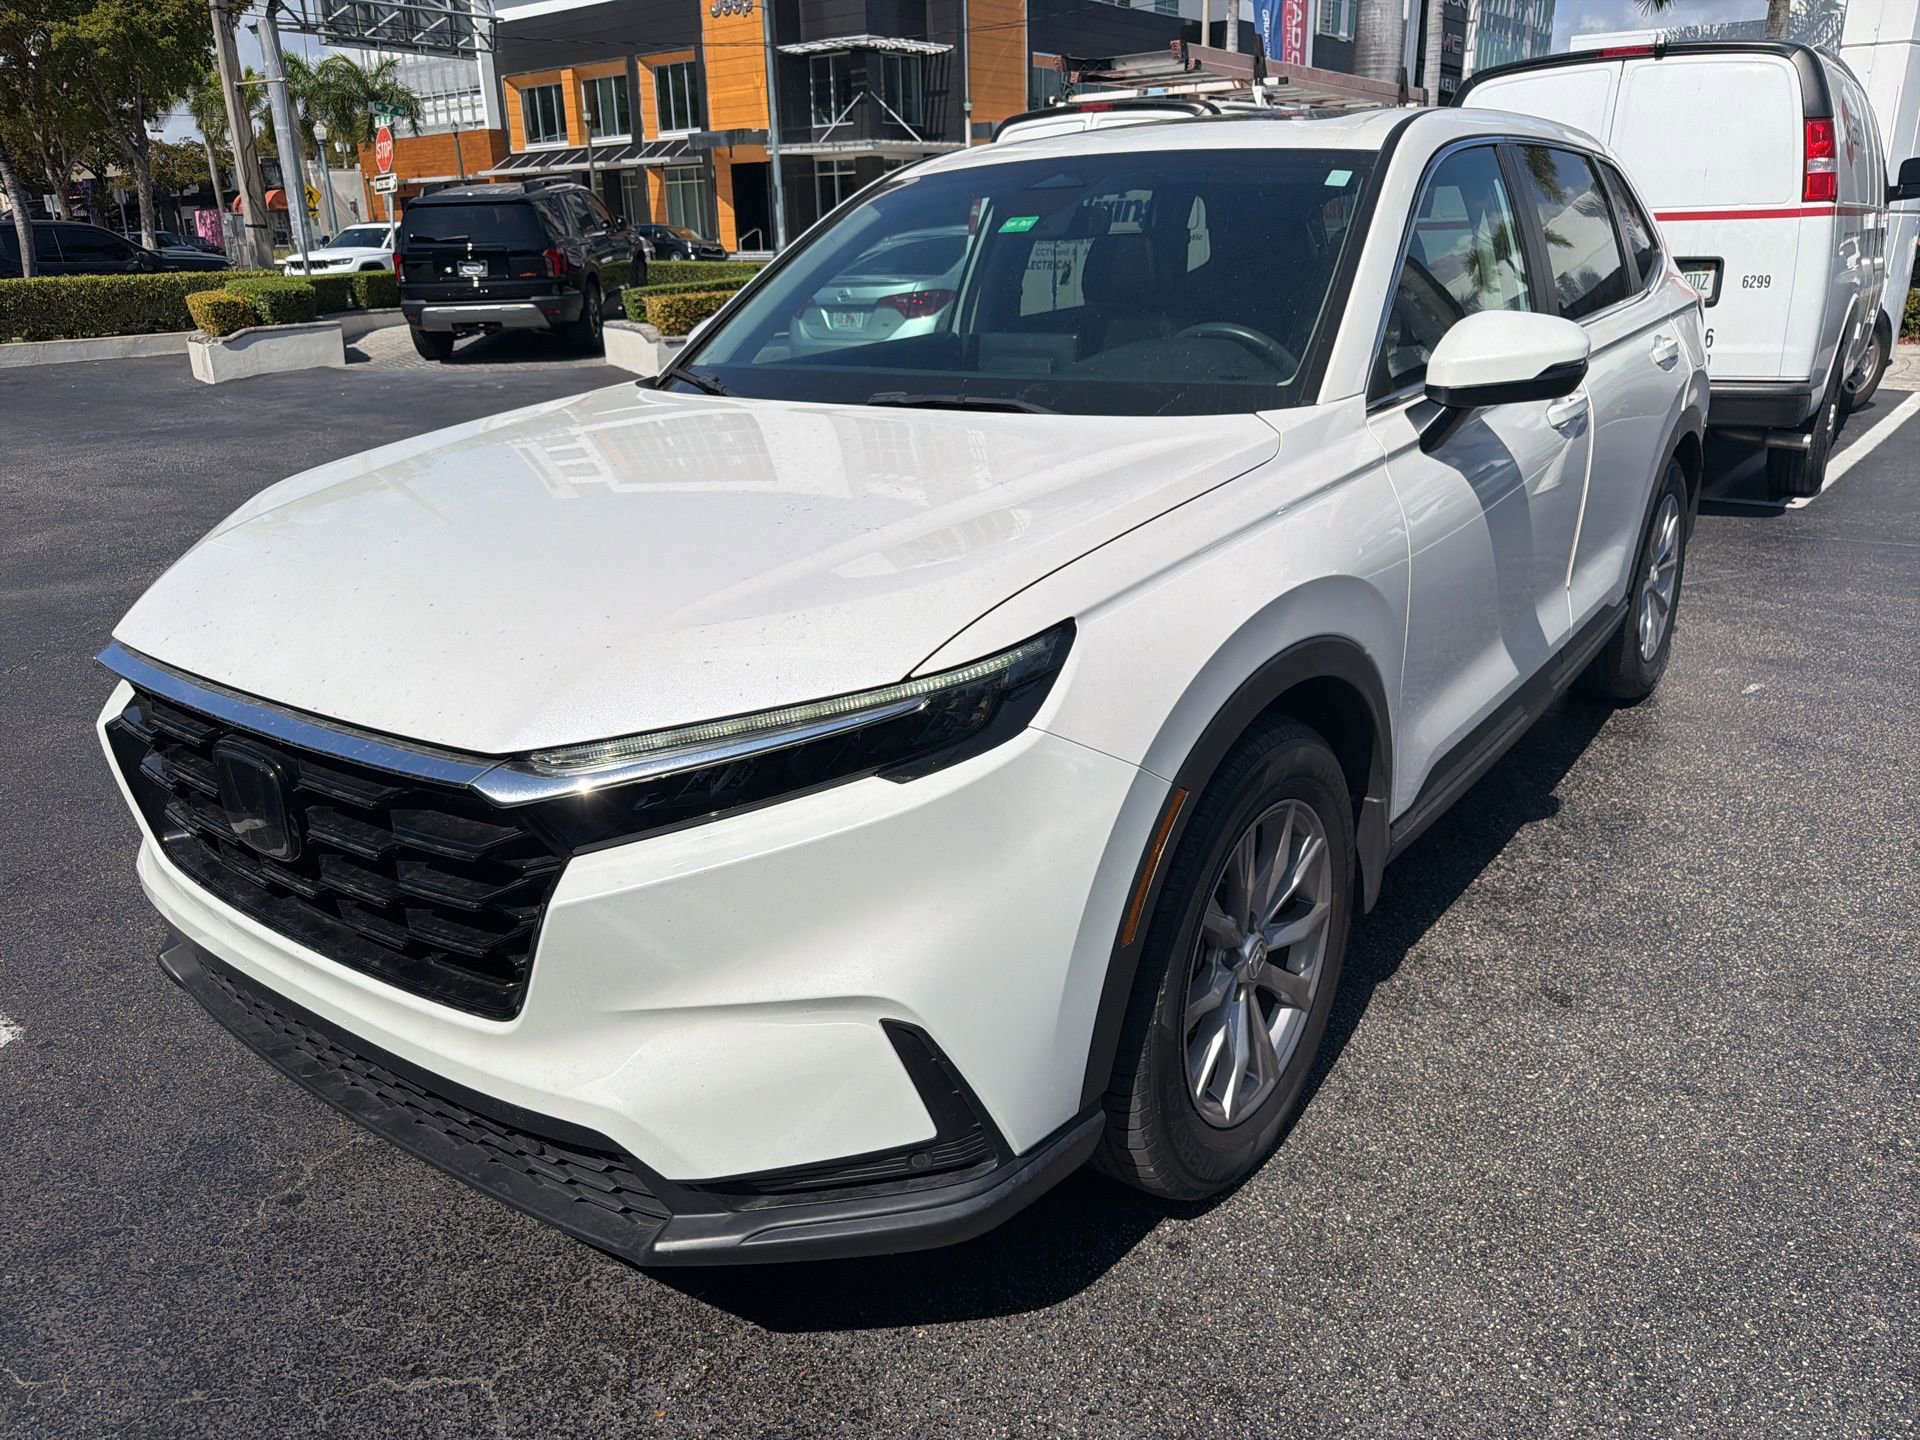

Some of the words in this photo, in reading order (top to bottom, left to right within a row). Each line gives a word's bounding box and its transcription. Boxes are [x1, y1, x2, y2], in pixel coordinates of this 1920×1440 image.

[1441, 32, 1463, 54] MC
[1440, 78, 1457, 92] KELL
[377, 141, 392, 160] STOP
[1742, 274, 1772, 289] 6299
